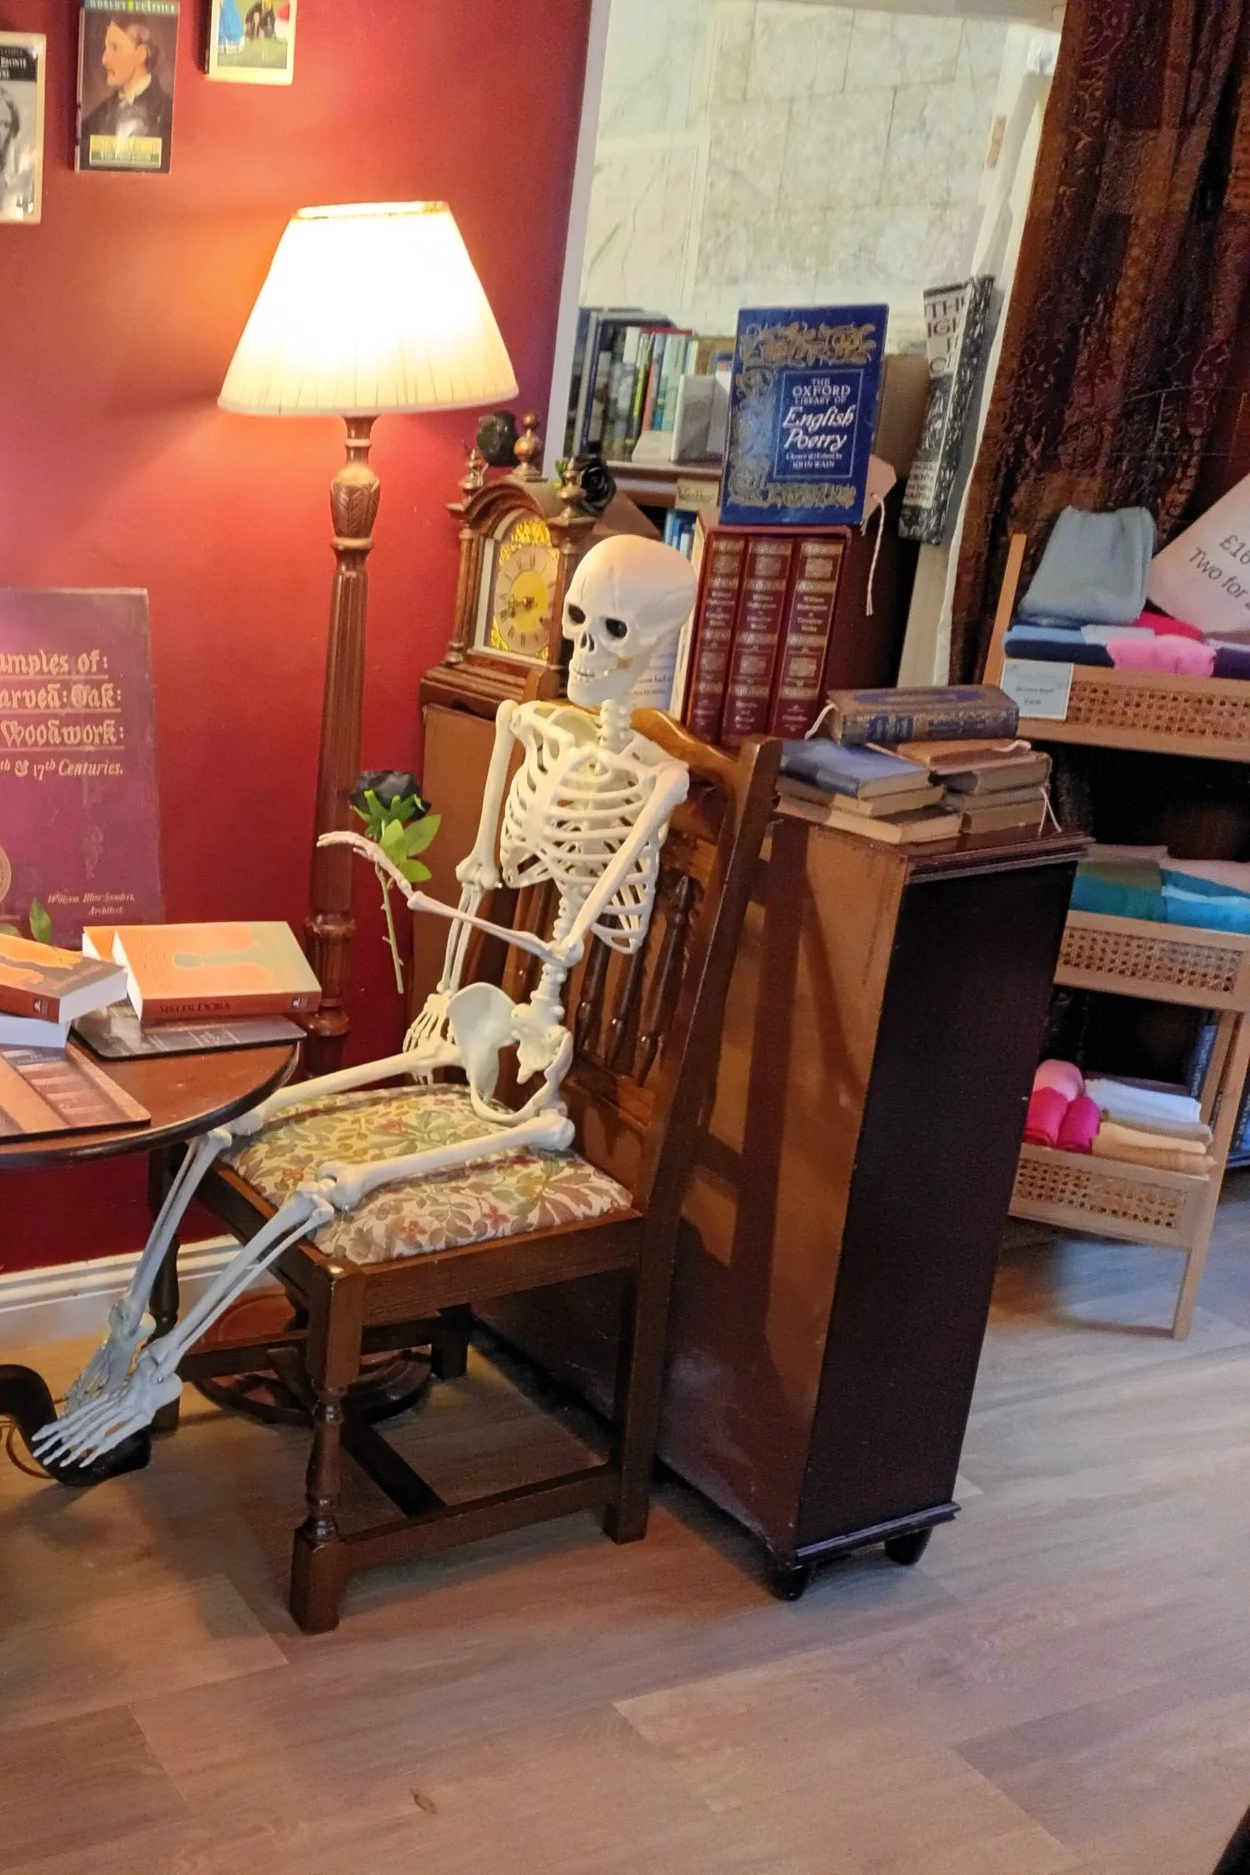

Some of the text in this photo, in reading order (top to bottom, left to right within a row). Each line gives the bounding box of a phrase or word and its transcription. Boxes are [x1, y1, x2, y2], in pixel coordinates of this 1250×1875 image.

[792, 385, 851, 397] OXFORD
[782, 404, 856, 433] English
[783, 428, 847, 452] Poetry
[1190, 546, 1249, 598] Two for
[159, 1001, 230, 1014] SISTER DORA
